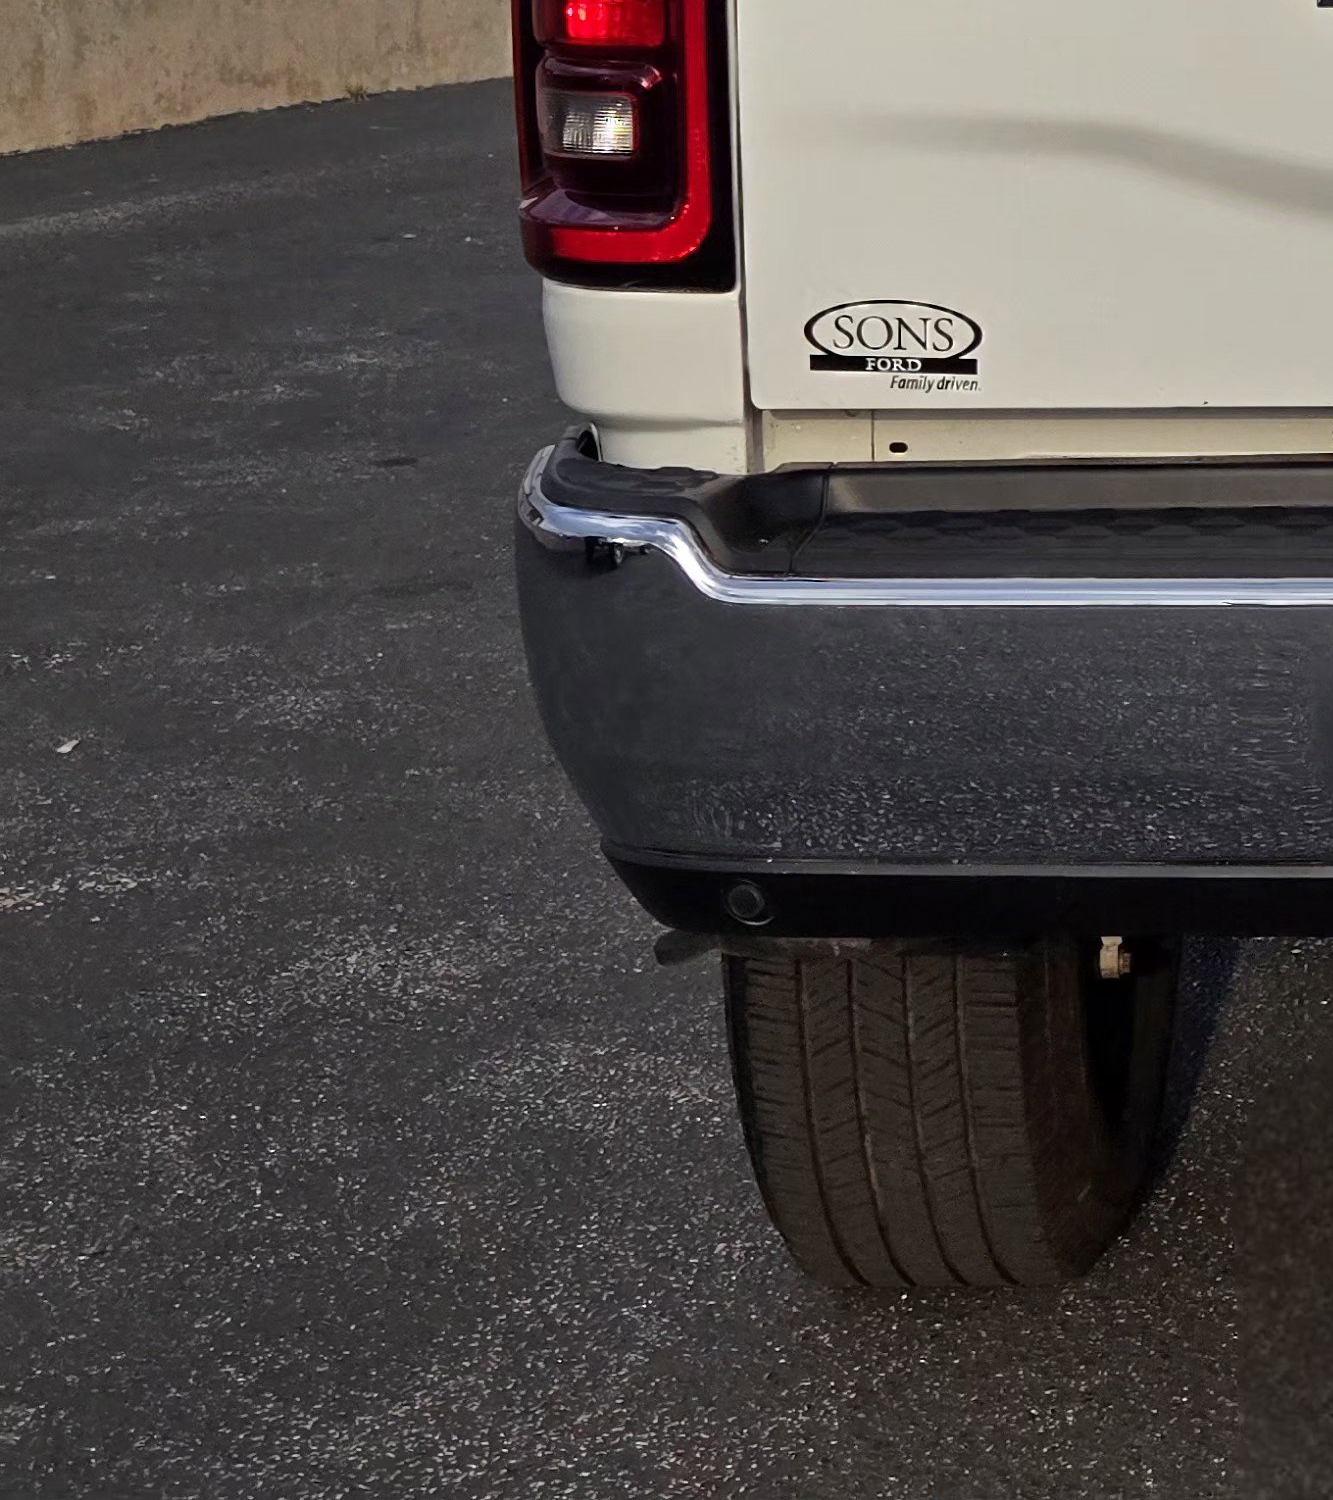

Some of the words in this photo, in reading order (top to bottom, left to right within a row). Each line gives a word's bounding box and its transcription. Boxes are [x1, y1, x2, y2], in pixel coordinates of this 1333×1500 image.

[832, 314, 954, 352] SONS
[864, 357, 922, 372] FORD
[889, 375, 935, 393] Family
